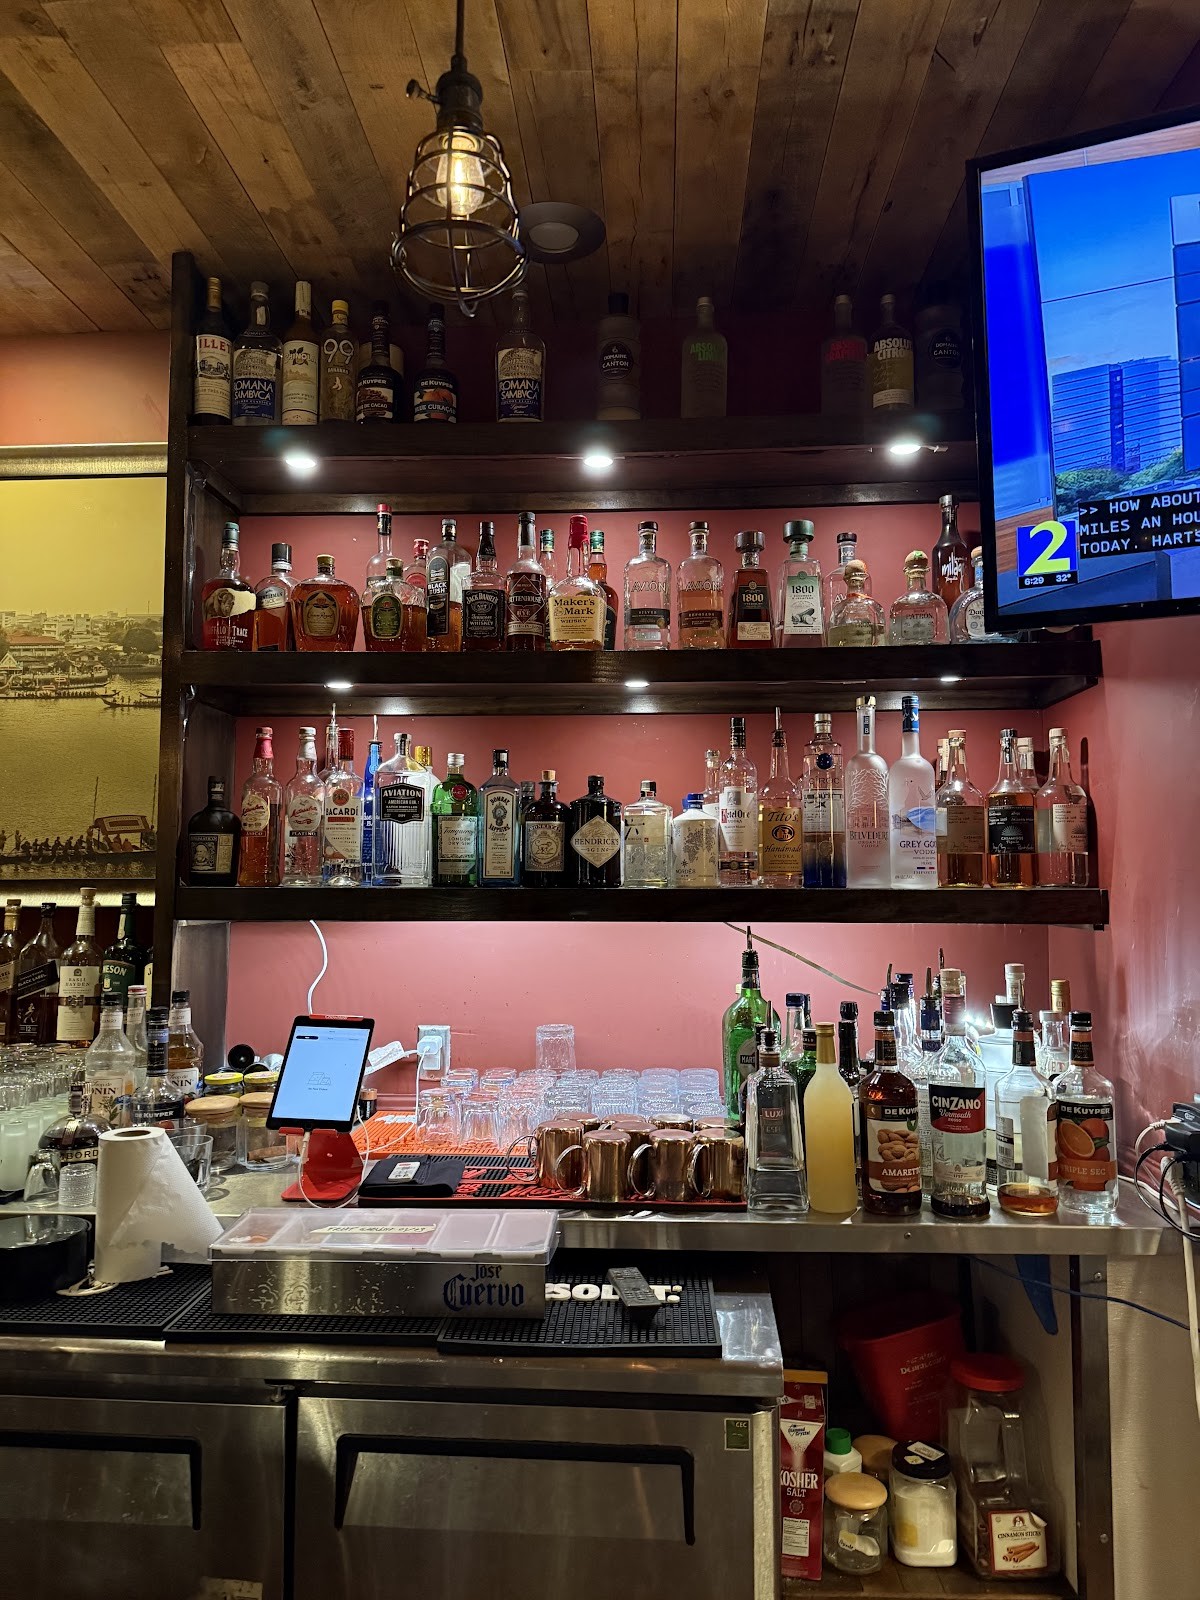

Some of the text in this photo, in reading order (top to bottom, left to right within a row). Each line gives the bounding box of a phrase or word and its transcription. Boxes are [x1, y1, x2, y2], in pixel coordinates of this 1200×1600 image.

[323, 337, 355, 365] 99
[873, 338, 913, 353] ABSOLUT
[877, 348, 906, 361] CITRO
[602, 360, 629, 369] CANTON
[1109, 498, 1141, 514] HOW
[1080, 518, 1132, 537] MILES
[1140, 515, 1162, 530] AN
[1024, 520, 1072, 576] 2
[1024, 575, 1045, 586] 6:29
[428, 583, 448, 592] BLACK
[791, 584, 815, 595] 1800
[466, 593, 479, 605] JACK
[554, 598, 597, 607] Maker's
[741, 592, 764, 604] 1800
[563, 606, 595, 615] Mark
[469, 620, 495, 629] WHISKEY
[232, 625, 249, 639] TRACE
[382, 788, 422, 799] AVIATION
[490, 796, 511, 806] BOMBAY
[326, 805, 359, 816] BACARDÍ
[767, 810, 799, 823] Tito's
[574, 837, 619, 845] HENDRICK'S
[849, 830, 889, 841] BELVEDERE
[899, 840, 922, 849] GREY
[18, 979, 33, 988] BLACK
[32, 973, 48, 983] LABEL
[931, 1096, 981, 1111] CINZANO
[938, 1109, 973, 1119] Vermouth
[881, 1167, 921, 1178] AMARETT
[1089, 1167, 1107, 1176] SEC
[442, 1272, 525, 1312] Cuervo
[545, 1282, 672, 1303] SOLT
[786, 1488, 807, 1498] SALT
